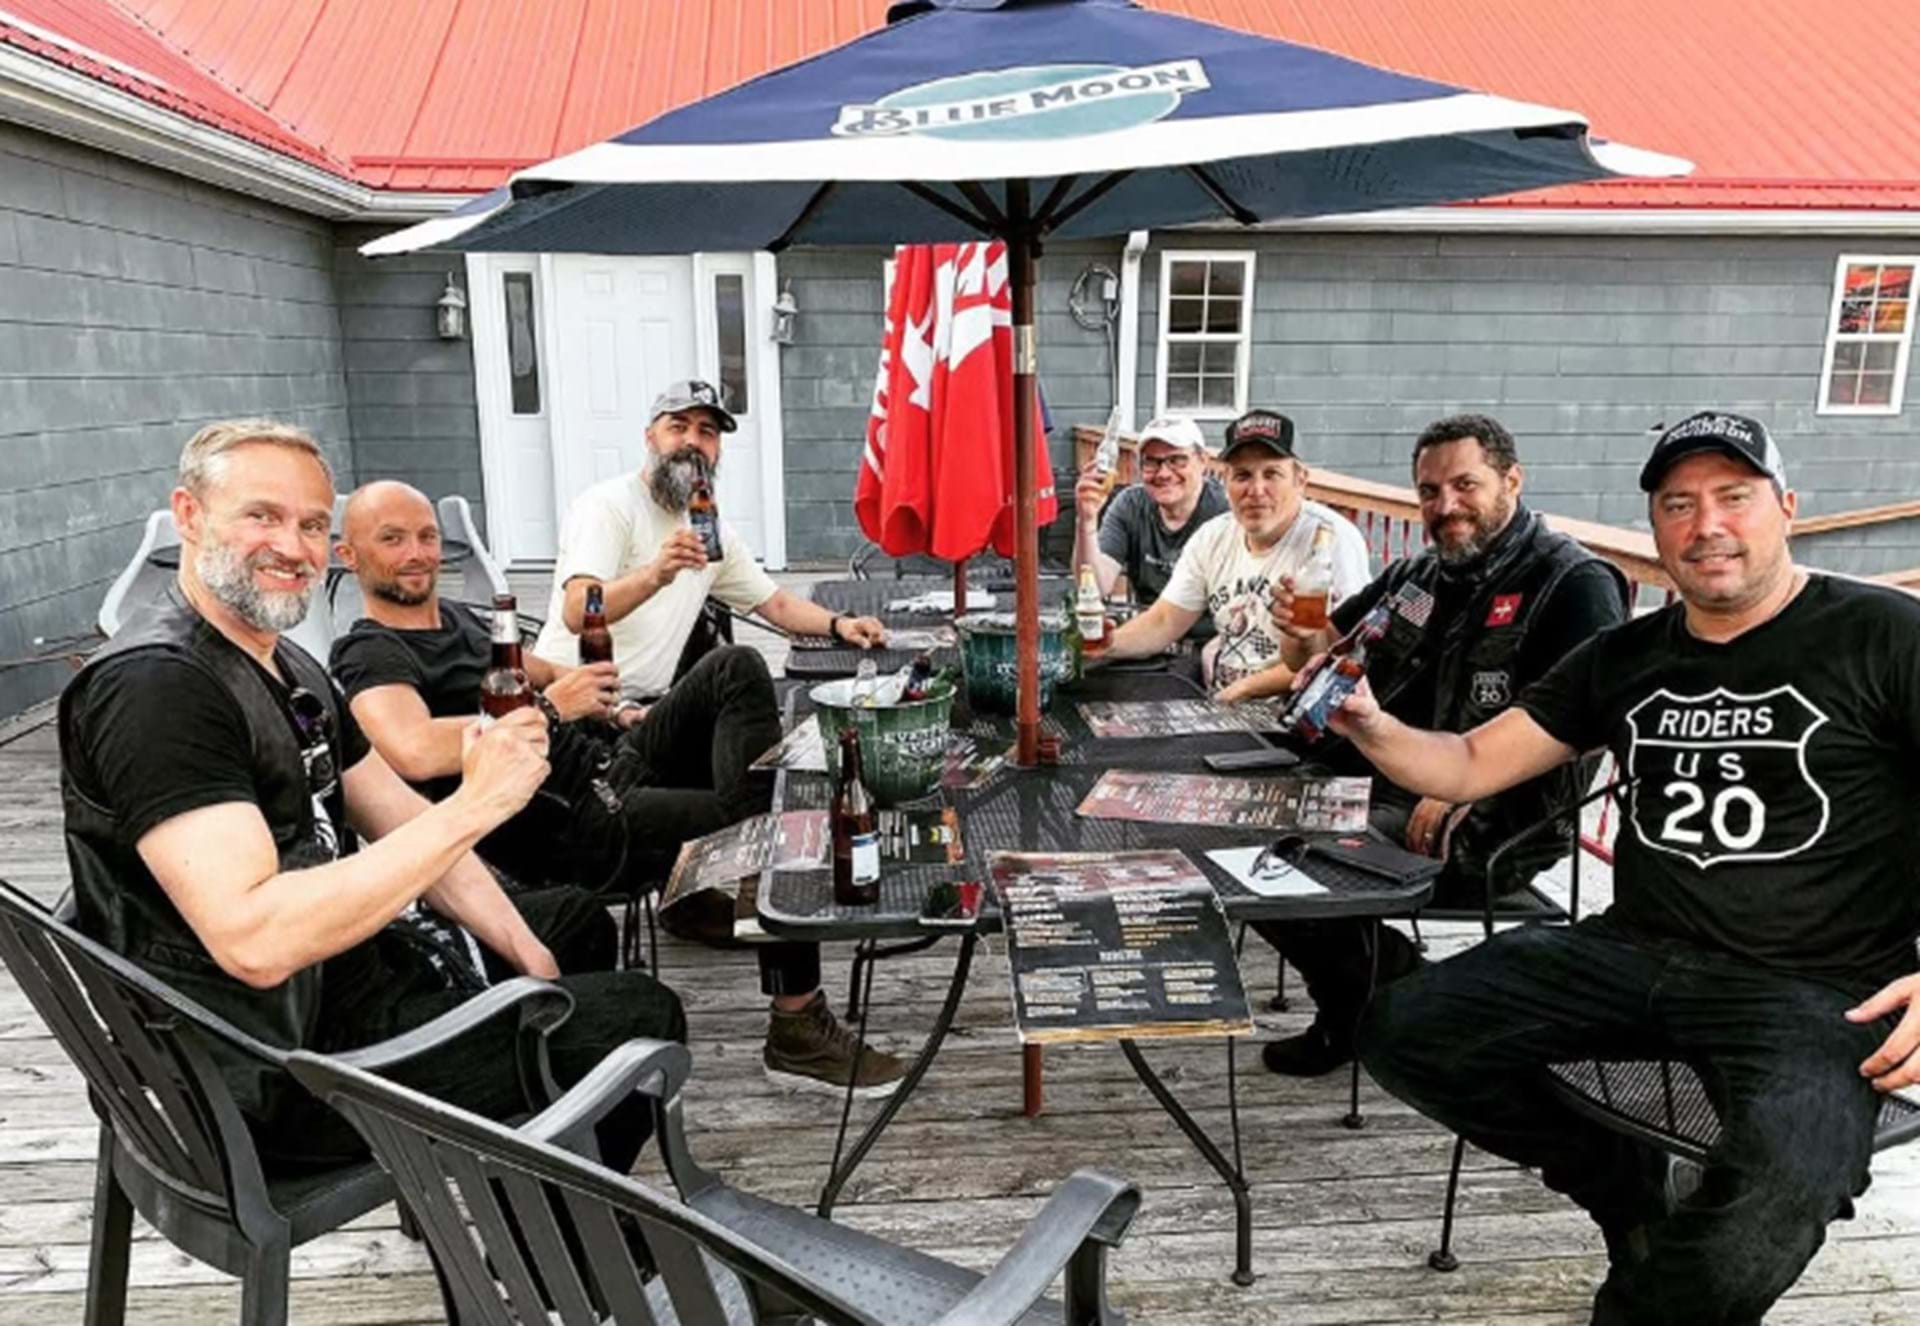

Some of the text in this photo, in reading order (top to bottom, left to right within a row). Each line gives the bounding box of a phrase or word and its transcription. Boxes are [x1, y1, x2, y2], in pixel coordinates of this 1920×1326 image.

[846, 67, 1190, 135] BLUE MOON
[1657, 706, 1774, 738] RIDERS
[1661, 781, 1766, 850] 20
